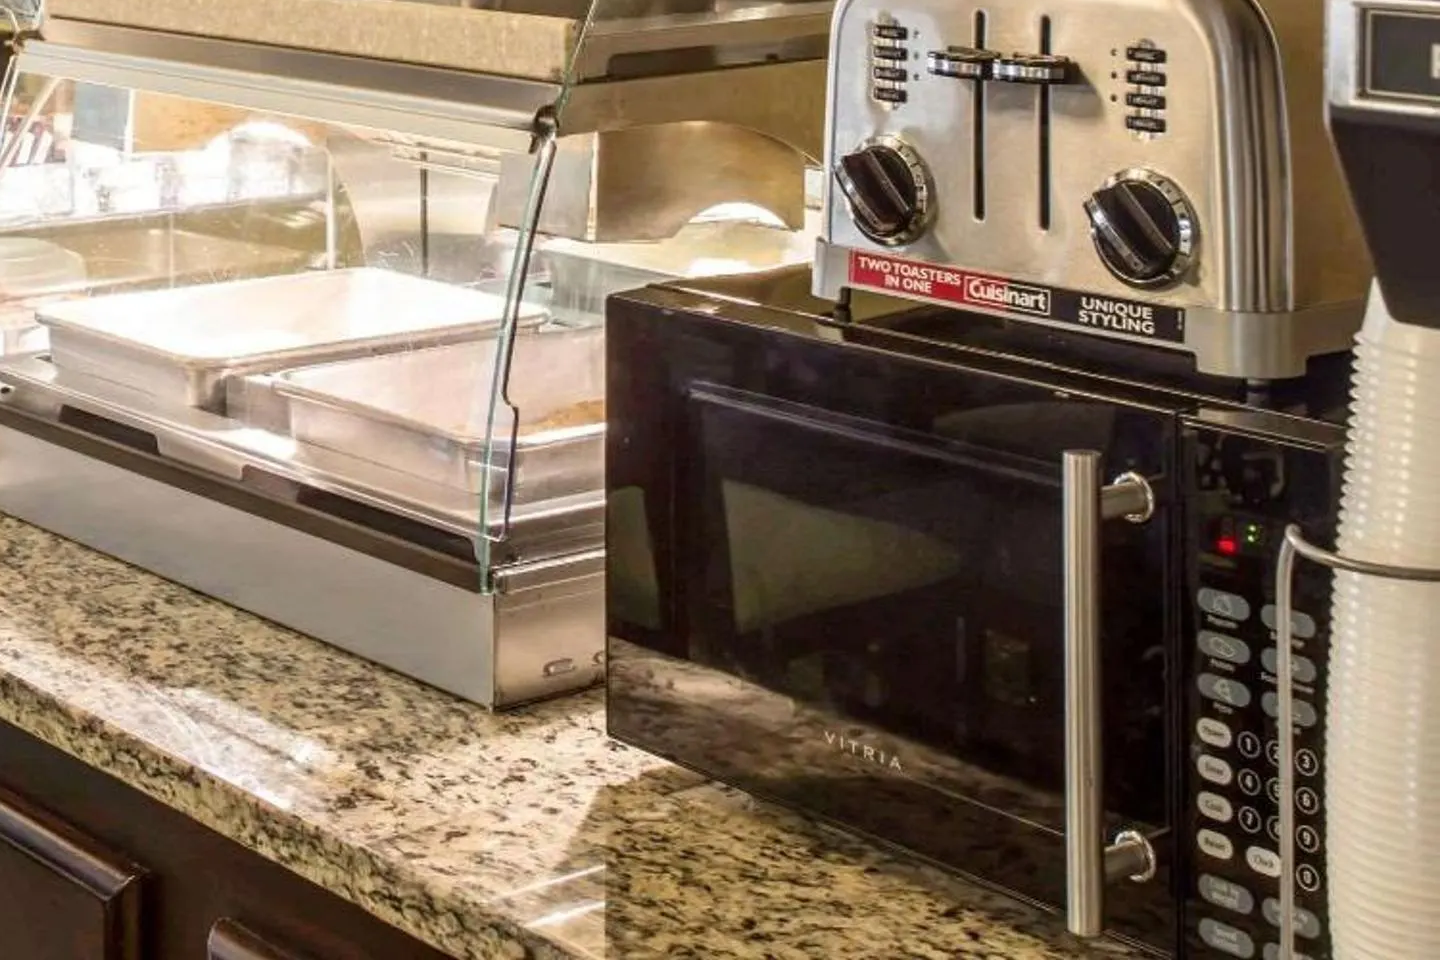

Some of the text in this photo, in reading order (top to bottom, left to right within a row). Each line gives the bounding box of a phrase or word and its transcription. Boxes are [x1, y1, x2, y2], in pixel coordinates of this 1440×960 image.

[858, 256, 961, 286] TWO TOASTERS
[884, 274, 933, 295] IN ONE
[969, 279, 1047, 311] Cuisinart
[1081, 296, 1153, 320] UNIQUE
[1078, 310, 1156, 335] STYLING
[824, 730, 902, 771] VITRIA
